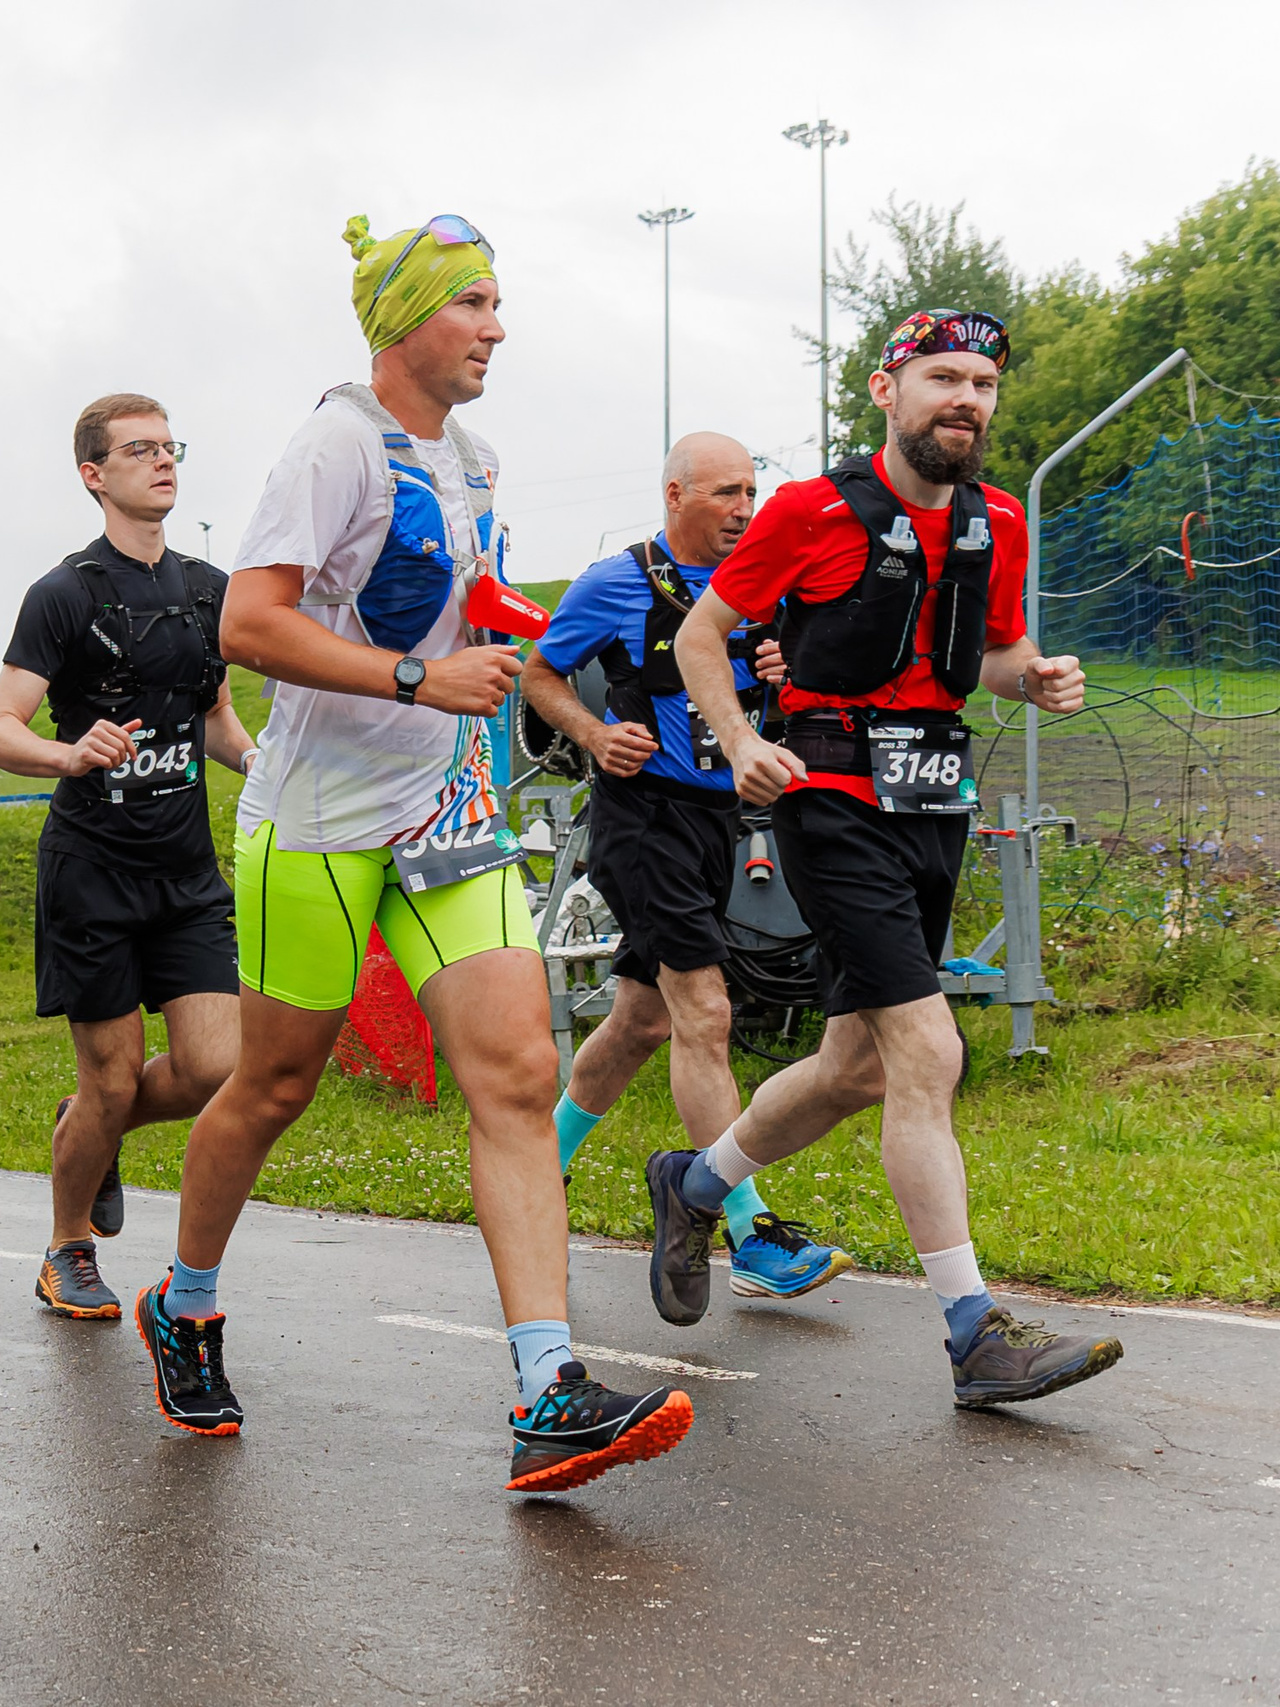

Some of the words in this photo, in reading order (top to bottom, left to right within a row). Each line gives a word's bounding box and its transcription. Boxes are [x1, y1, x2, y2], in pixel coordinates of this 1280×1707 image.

[110, 742, 192, 779] 3043
[896, 740, 908, 749] 30
[882, 752, 961, 786] 3148
